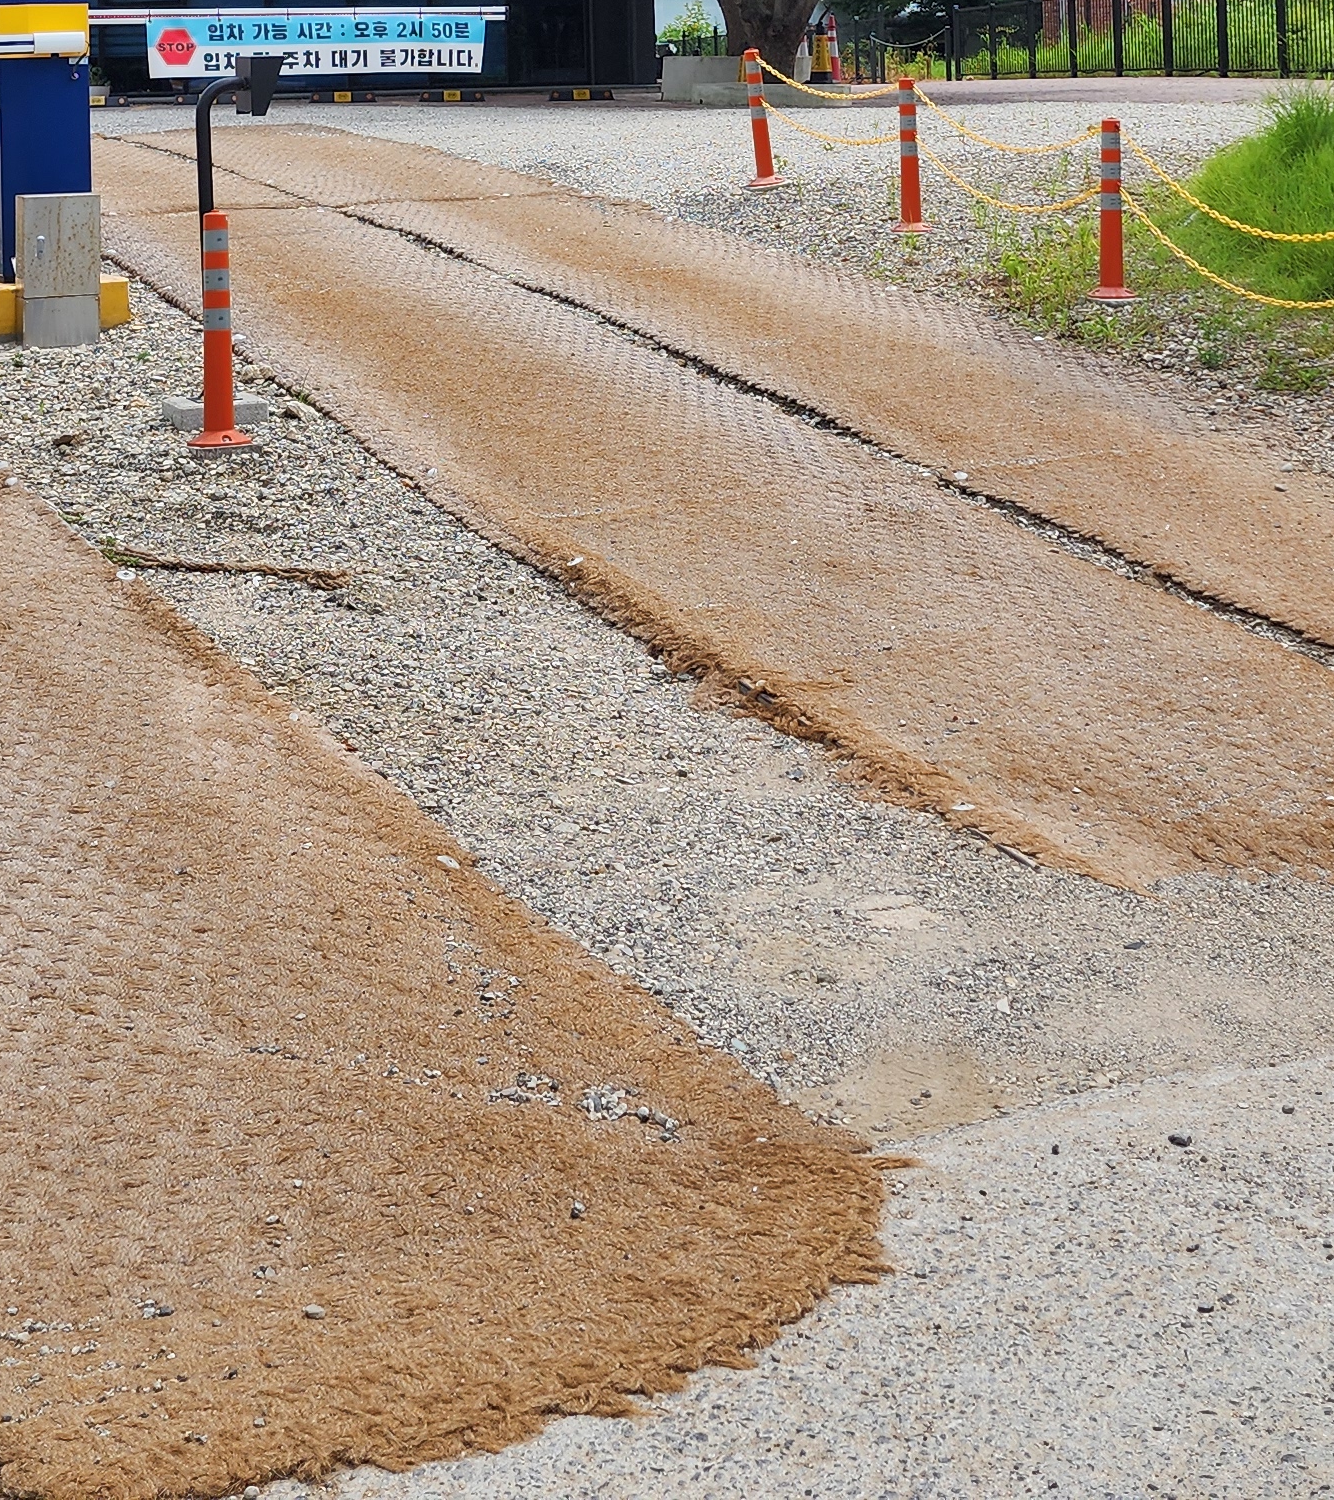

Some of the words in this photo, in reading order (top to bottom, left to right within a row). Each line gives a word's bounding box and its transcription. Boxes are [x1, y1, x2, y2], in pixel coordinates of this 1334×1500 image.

[208, 23, 244, 41] 입차
[252, 23, 288, 40] 가능
[298, 22, 332, 40] 시간
[354, 21, 388, 38] 오후
[397, 21, 423, 38] 2시
[431, 22, 470, 39] 50분
[158, 43, 194, 52] STOP
[282, 50, 321, 69] 주차
[332, 49, 368, 68] 대기
[379, 49, 478, 68] 불가합니다.
